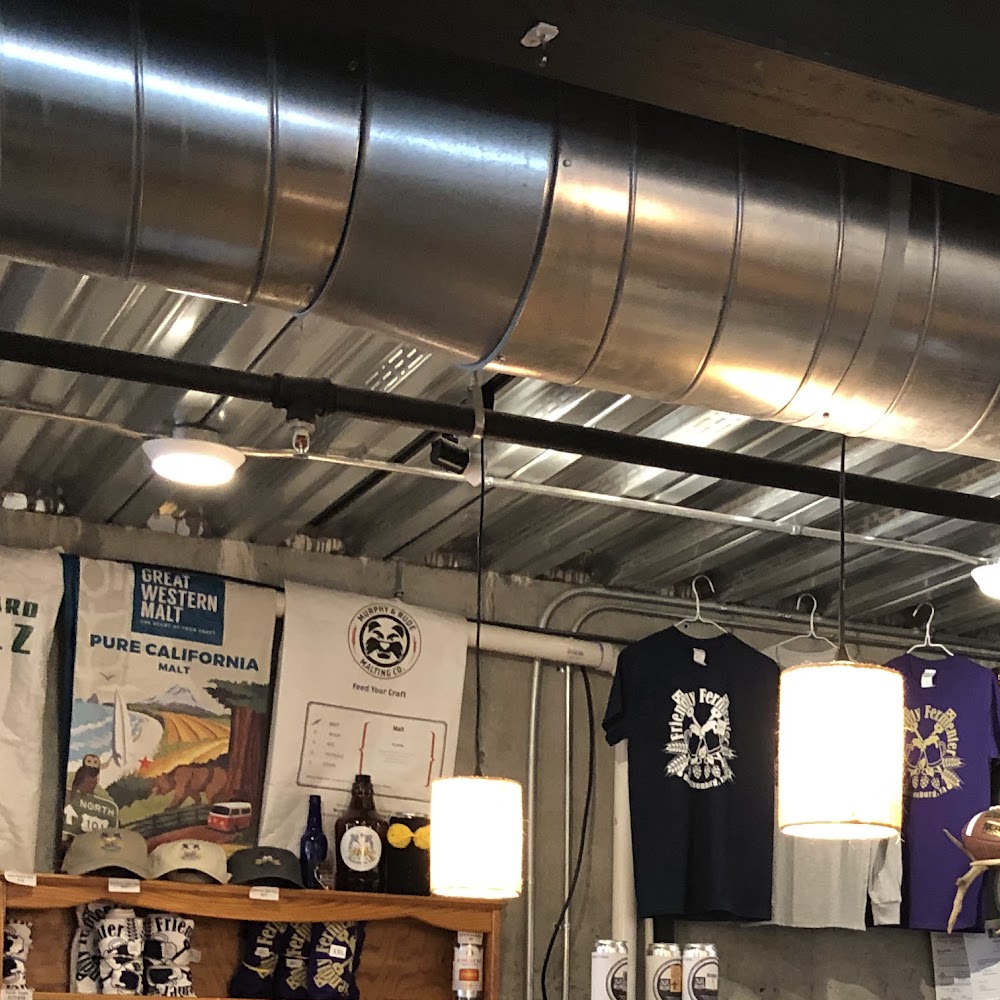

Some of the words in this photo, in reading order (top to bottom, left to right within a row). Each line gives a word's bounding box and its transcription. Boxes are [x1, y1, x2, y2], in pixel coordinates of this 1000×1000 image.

[141, 568, 190, 589] GREAT
[0, 597, 38, 617] RD
[141, 583, 218, 613] WESTERN
[140, 601, 184, 623] MALT
[357, 605, 388, 622] MURPHY
[398, 612, 416, 632] RUDE
[90, 633, 141, 654] PURE
[145, 643, 259, 671] CALIFORNIA
[158, 662, 191, 675] MALT
[360, 658, 392, 678] MALTING
[392, 665, 406, 677] CO.
[352, 683, 370, 692] Feed
[371, 685, 388, 696] Your
[388, 689, 407, 699] Craft
[79, 798, 115, 815] NORTH
